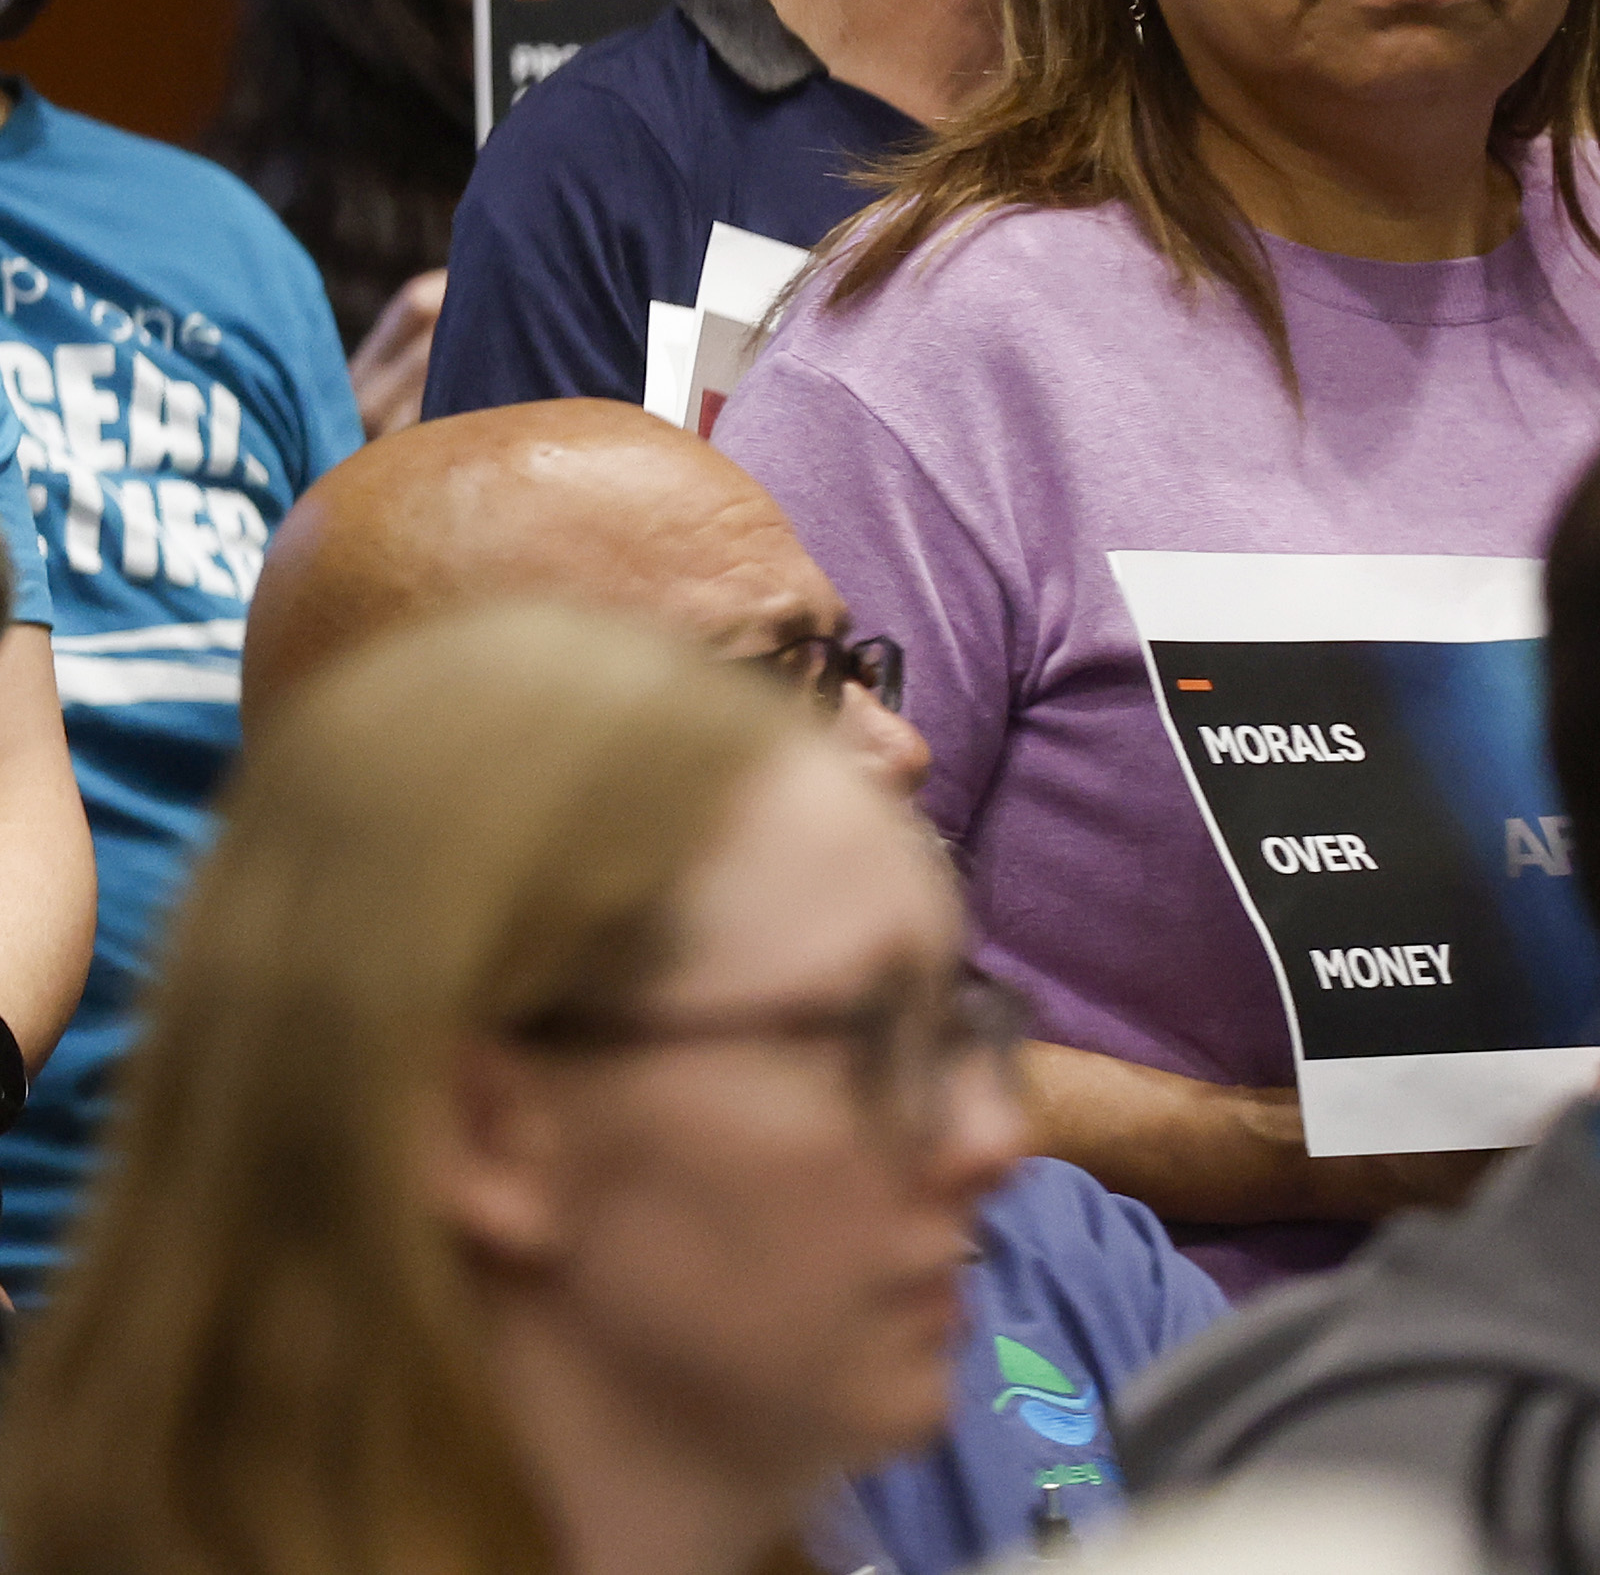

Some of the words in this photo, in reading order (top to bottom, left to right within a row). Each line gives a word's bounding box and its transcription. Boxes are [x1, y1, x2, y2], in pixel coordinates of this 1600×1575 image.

[1197, 722, 1367, 766] MORALS
[1259, 833, 1380, 876] OVER
[1308, 942, 1455, 991] MONEY
